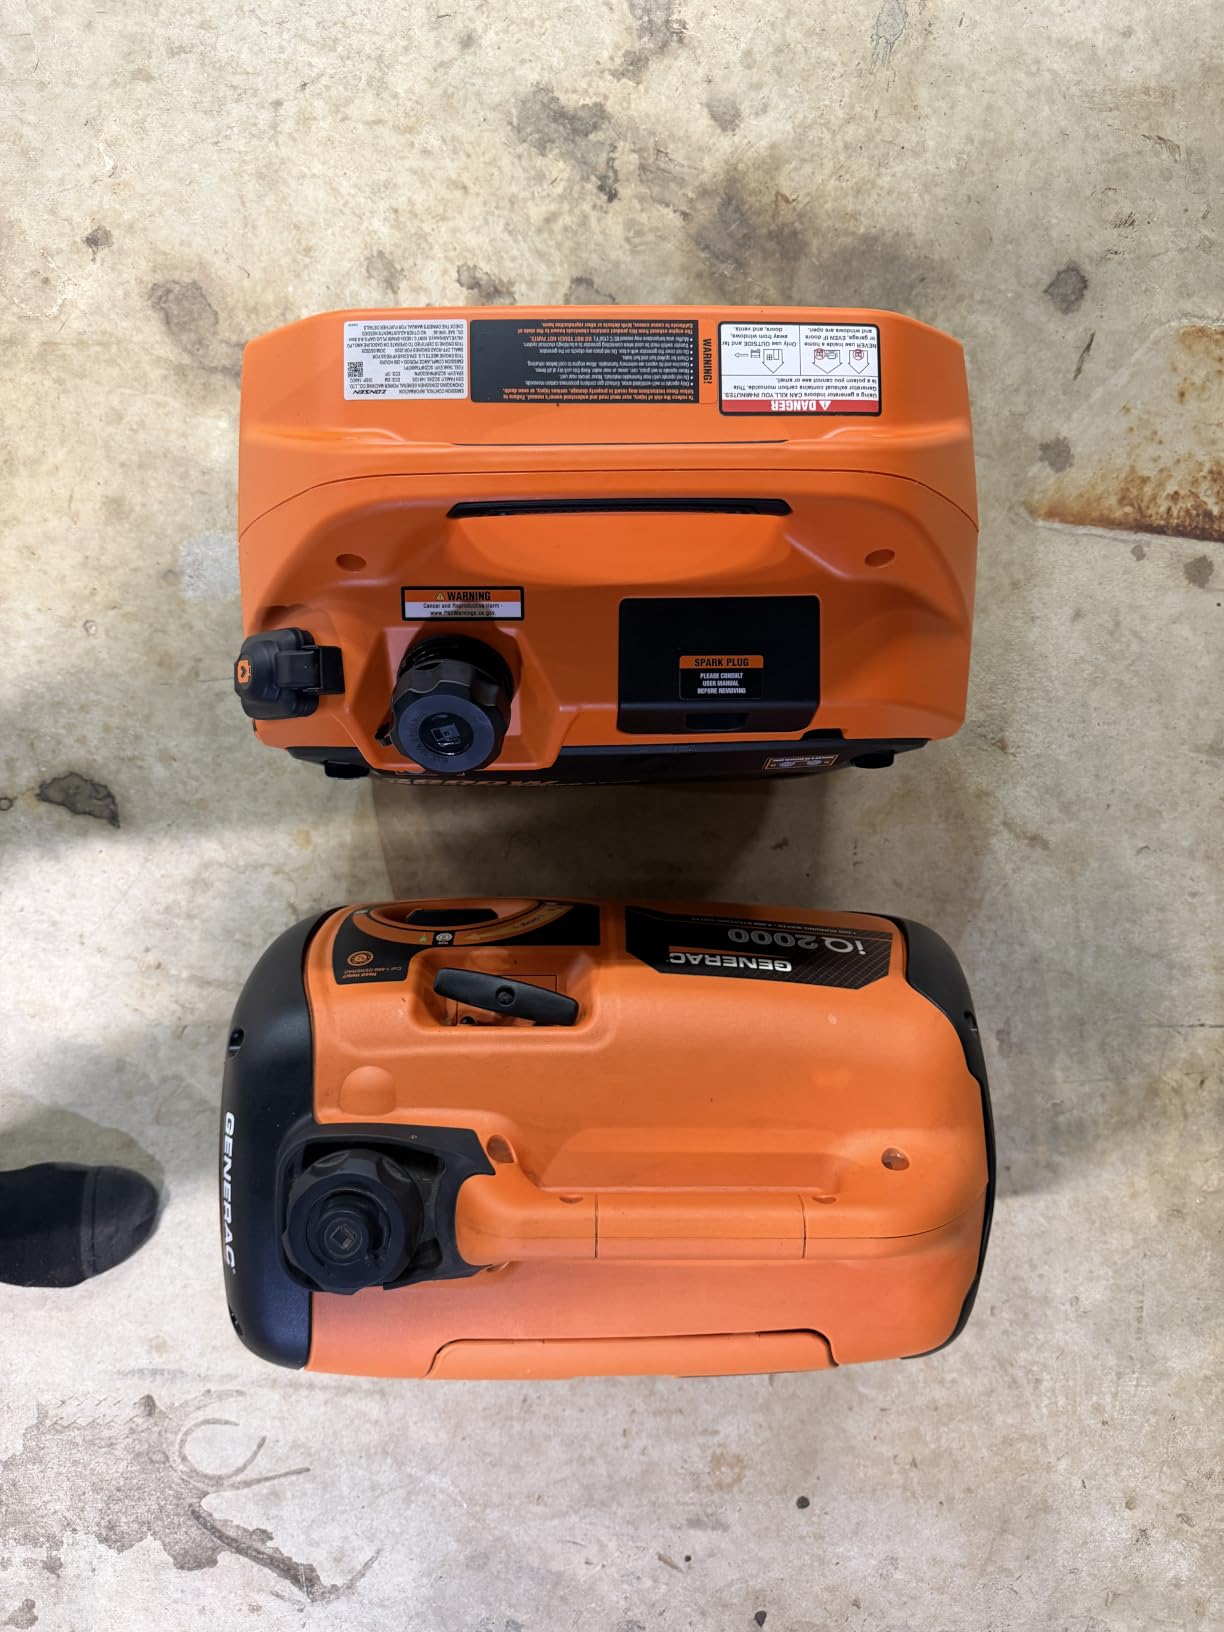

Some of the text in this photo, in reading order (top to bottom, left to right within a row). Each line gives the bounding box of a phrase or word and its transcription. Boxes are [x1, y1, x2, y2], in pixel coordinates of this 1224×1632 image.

[703, 339, 712, 384] WARNING!
[771, 401, 816, 411] DANGER
[447, 592, 490, 600] WARNING
[695, 658, 749, 666] SPARK PLUG
[669, 952, 793, 972] GENERAC
[223, 1112, 235, 1268] GENERAC
